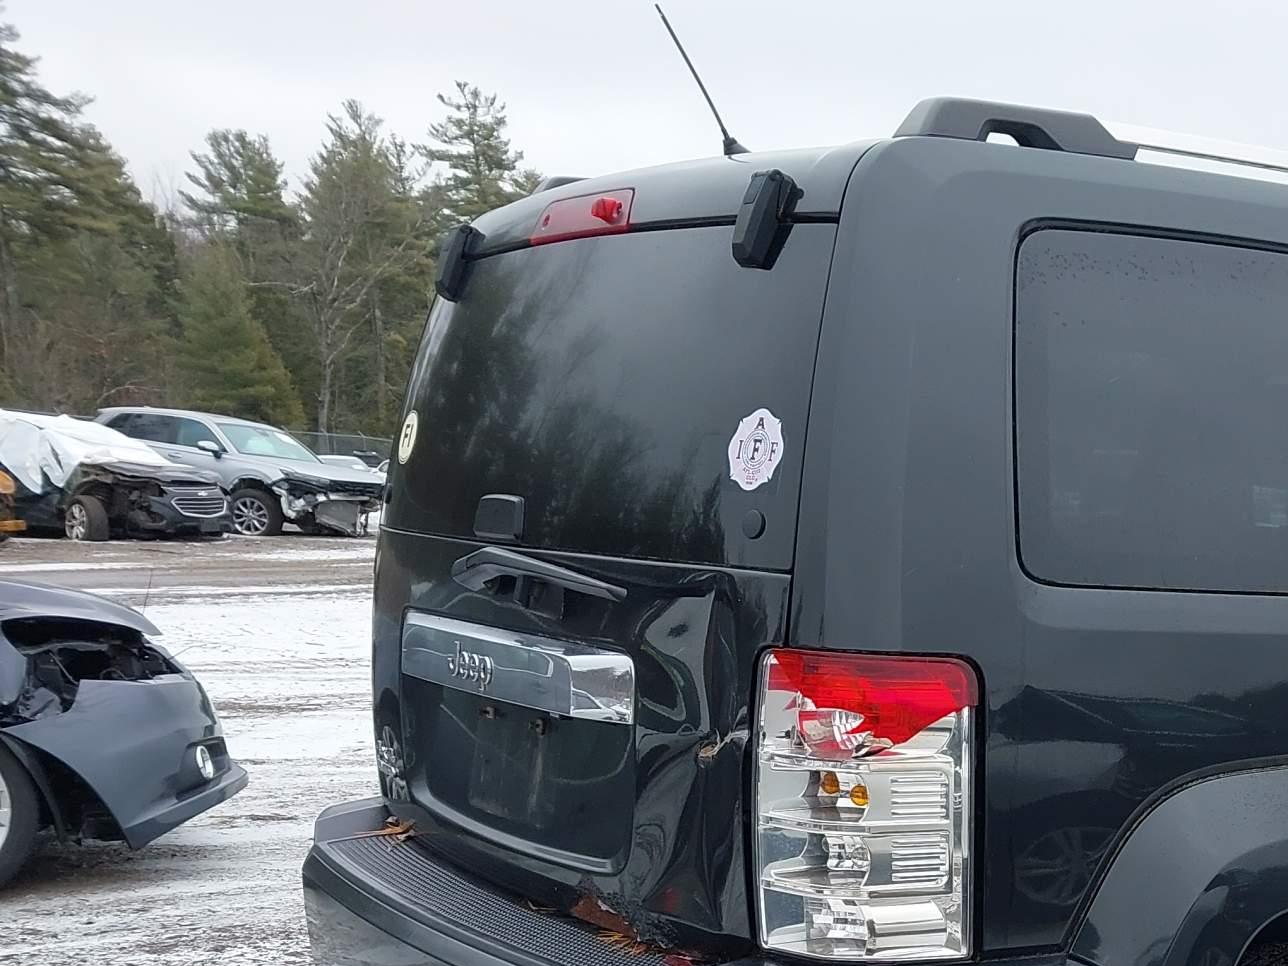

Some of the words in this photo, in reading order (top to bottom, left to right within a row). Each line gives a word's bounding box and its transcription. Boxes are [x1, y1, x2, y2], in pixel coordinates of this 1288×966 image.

[754, 417, 766, 430] A
[750, 439, 762, 460] F
[768, 441, 778, 461] F
[447, 640, 495, 692] Jeep
